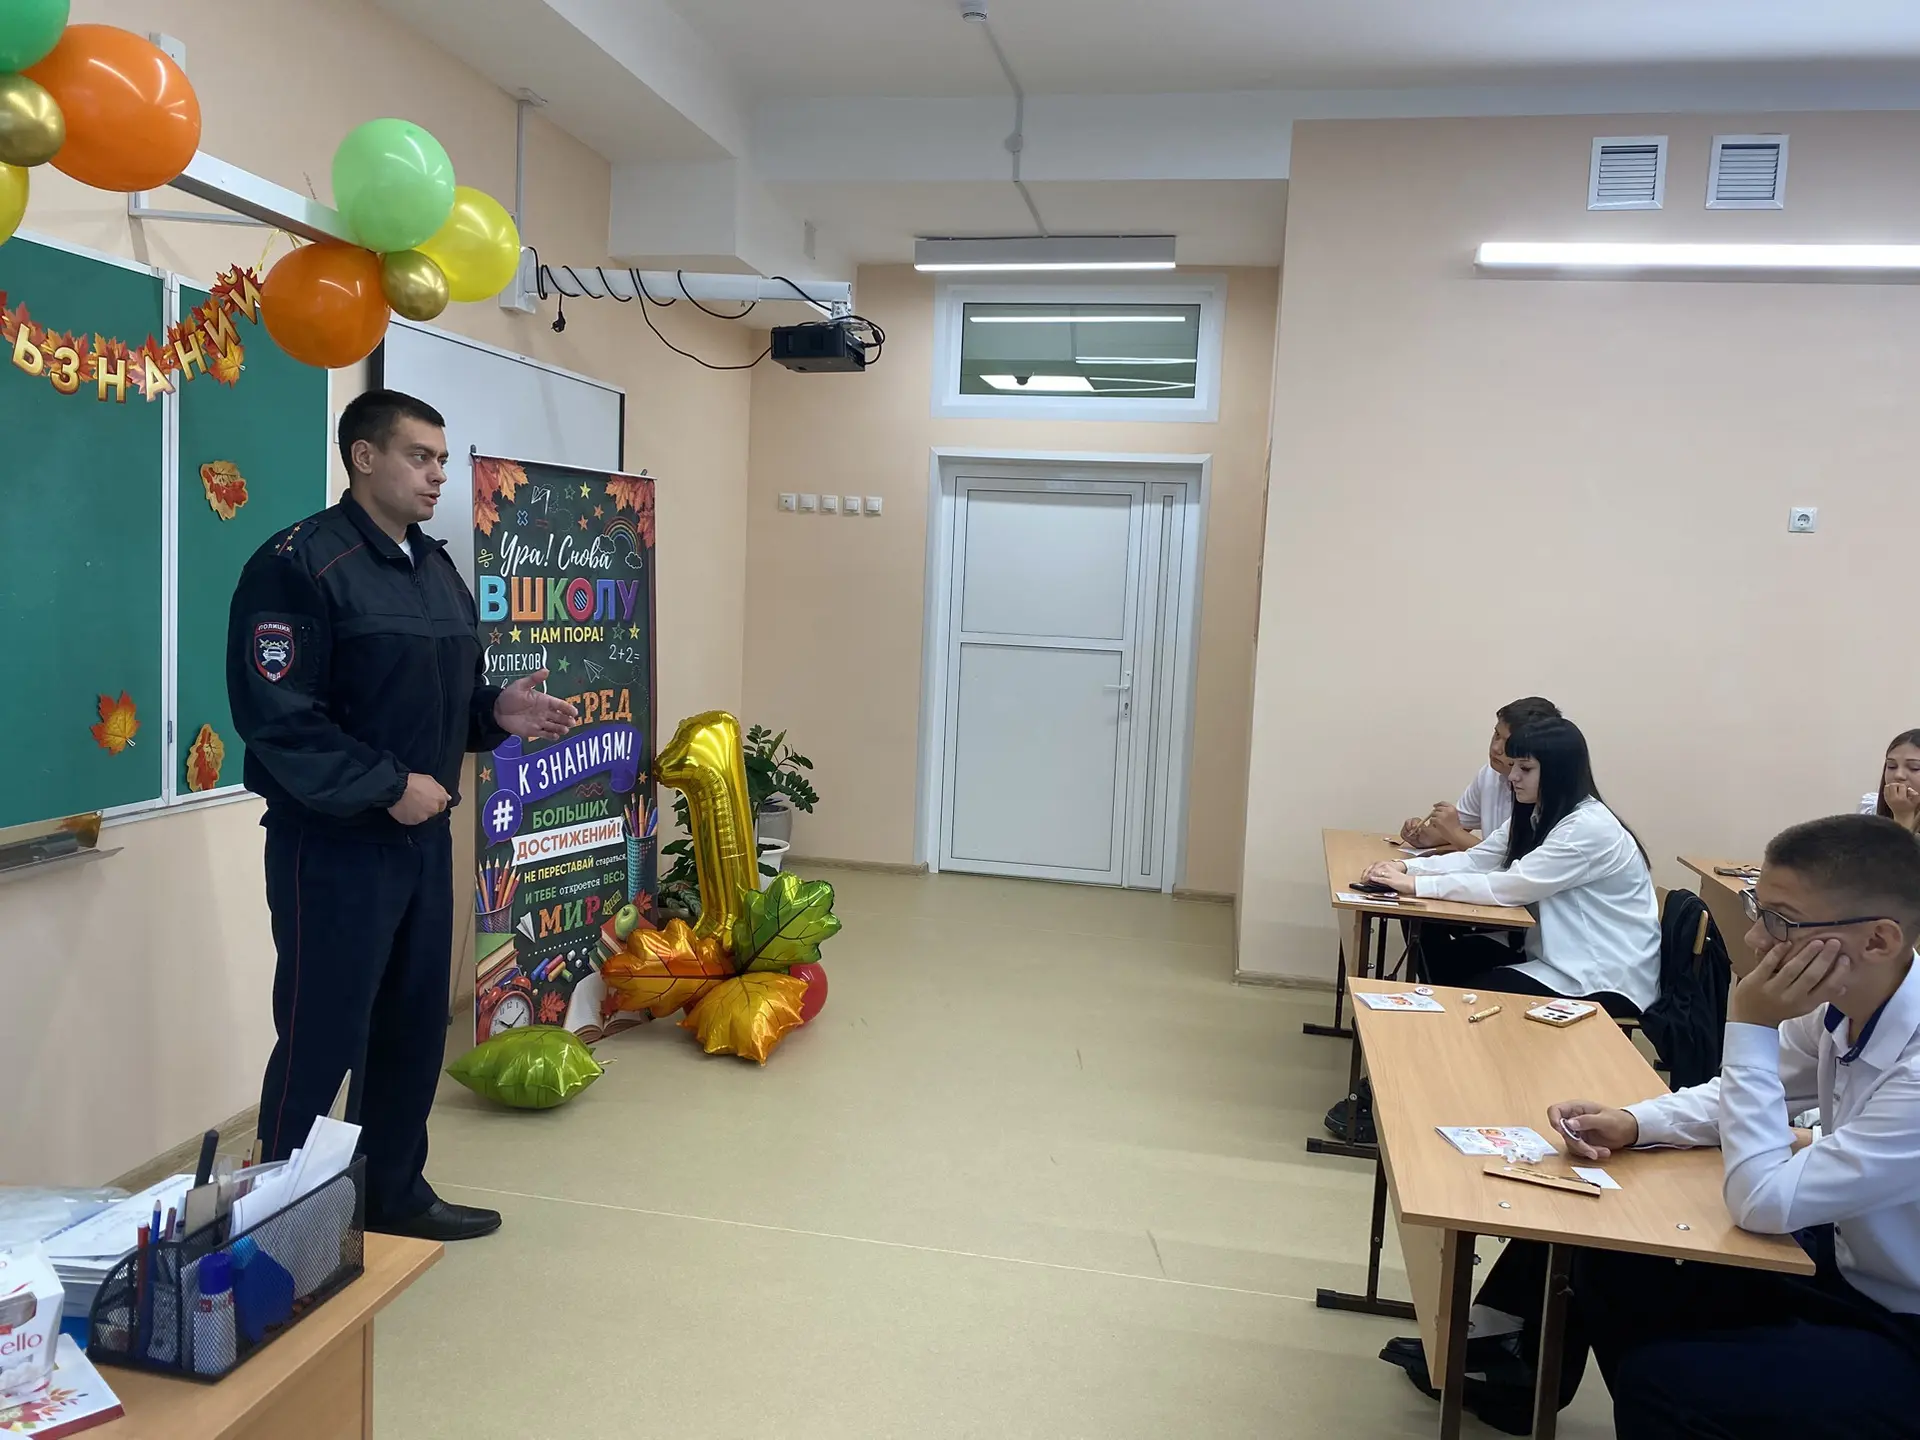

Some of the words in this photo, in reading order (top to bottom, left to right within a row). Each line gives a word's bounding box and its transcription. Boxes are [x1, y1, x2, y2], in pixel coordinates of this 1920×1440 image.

[500, 531, 554, 578] Ура!
[557, 534, 613, 570] Снова
[530, 627, 562, 643] НАМ
[564, 626, 604, 643] ПОРА!
[490, 652, 542, 673] УСПЕХОВ
[608, 644, 640, 664] 2+2=
[518, 762, 532, 796] К
[538, 731, 633, 790] ЗНАНИЯМ!
[532, 799, 609, 830] БОЛЬШИХ
[516, 819, 621, 862] ДОСТИЖЕНИЙ!
[524, 871, 536, 884] НЕ
[538, 855, 594, 881] ПЕРЕСТАВАЙ
[525, 892, 533, 905] И
[534, 886, 557, 903] ТЕБЕ
[559, 878, 601, 896] откроется
[603, 870, 625, 885] ВЕСЬ
[538, 895, 601, 939] МИР
